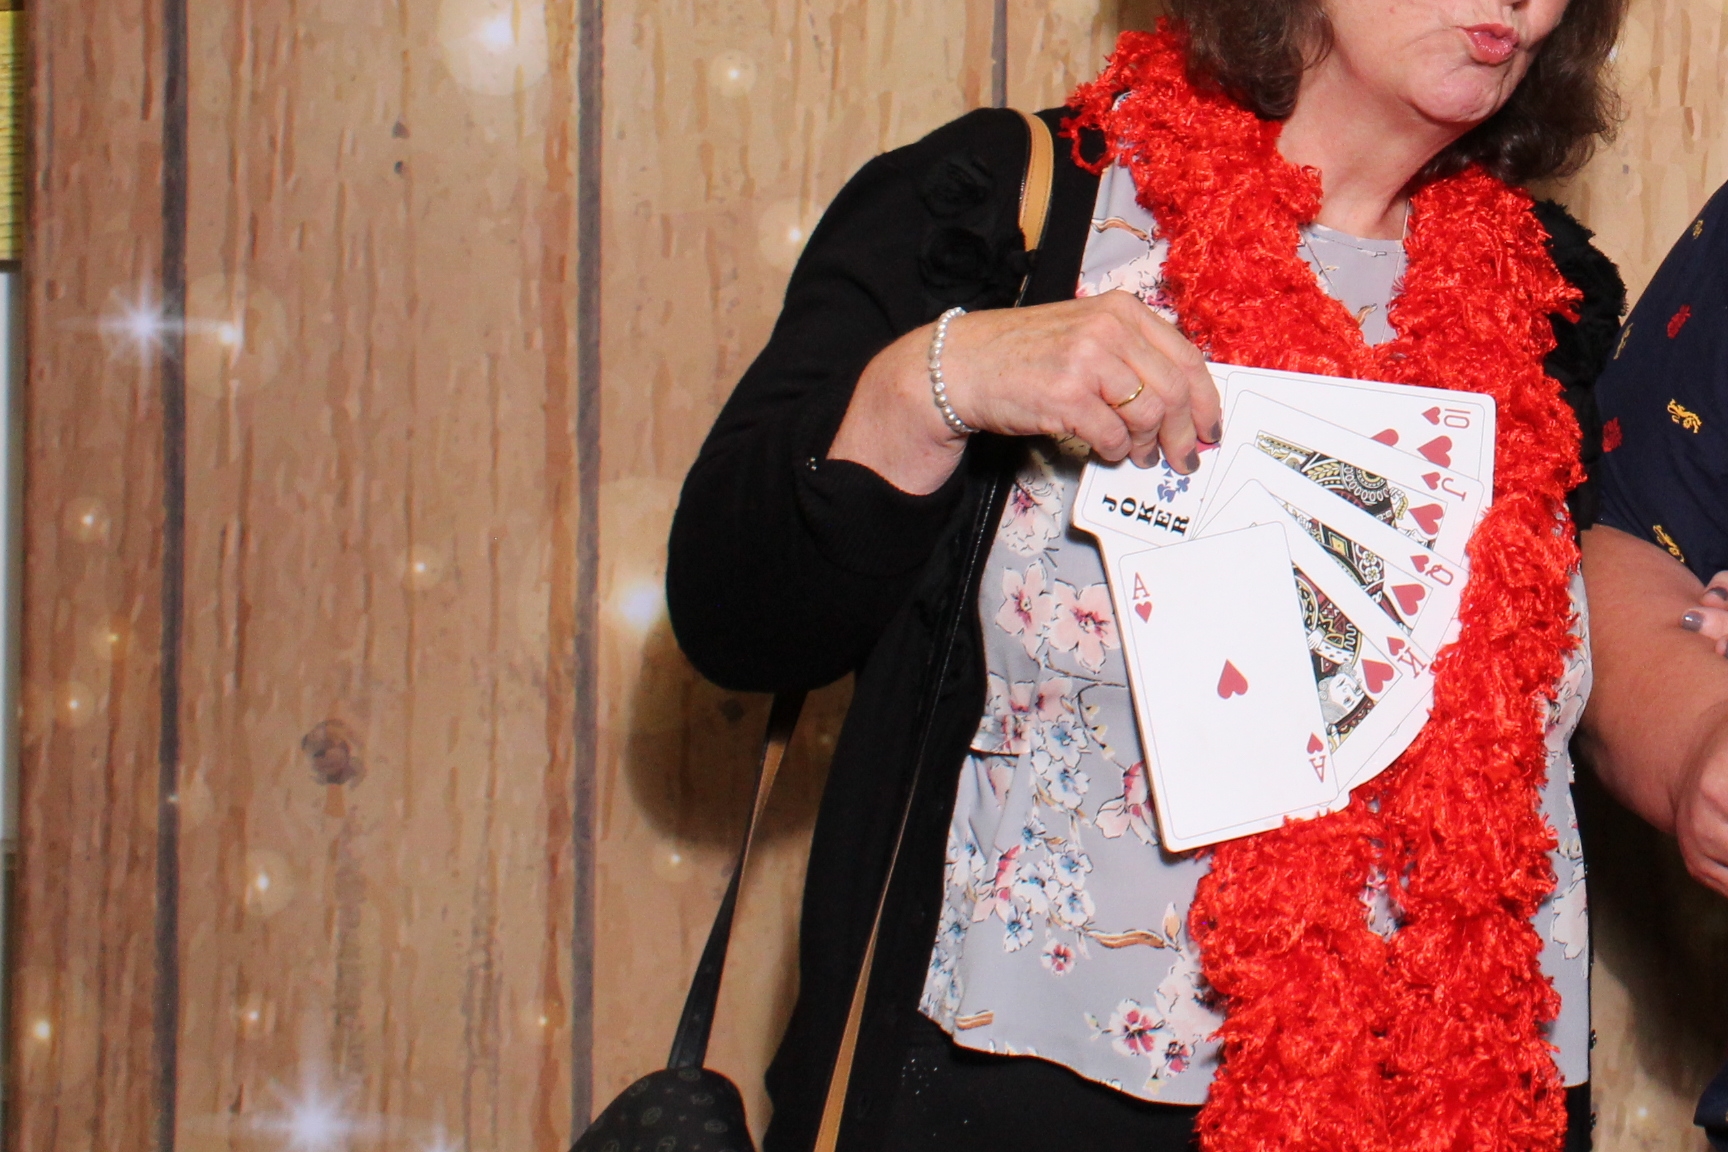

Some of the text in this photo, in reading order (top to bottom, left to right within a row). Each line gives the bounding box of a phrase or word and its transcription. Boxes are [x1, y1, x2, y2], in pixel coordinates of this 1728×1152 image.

[1443, 408, 1472, 430] 10
[1441, 477, 1467, 502] J
[1102, 493, 1190, 537] JOKER
[1131, 571, 1151, 601] A
[1425, 564, 1454, 586] Q
[1397, 646, 1428, 679] K
[1308, 754, 1328, 784] A
